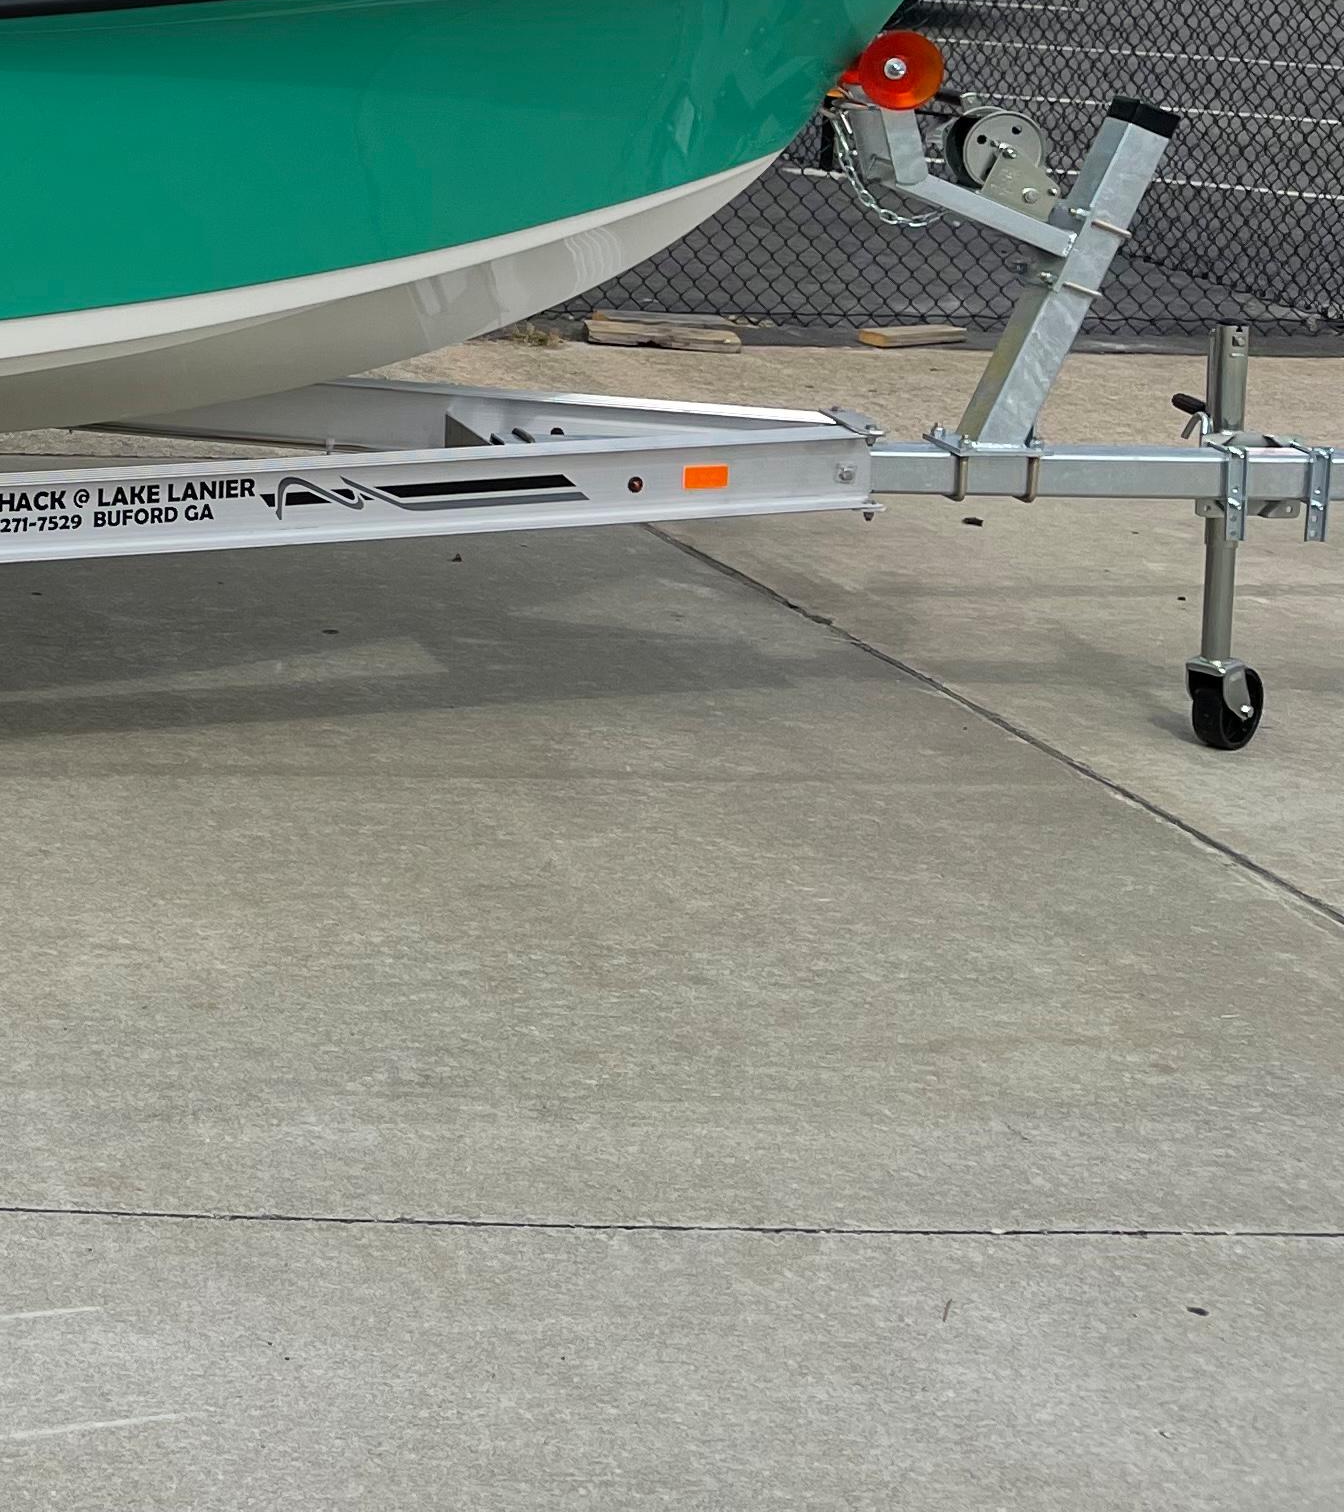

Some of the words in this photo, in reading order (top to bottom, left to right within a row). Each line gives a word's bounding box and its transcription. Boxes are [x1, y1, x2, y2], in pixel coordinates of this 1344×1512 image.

[73, 488, 90, 509] @
[97, 484, 161, 507] LAKE
[167, 478, 256, 502] LANIER
[93, 506, 179, 529] BUFORD
[184, 503, 214, 522] GA
